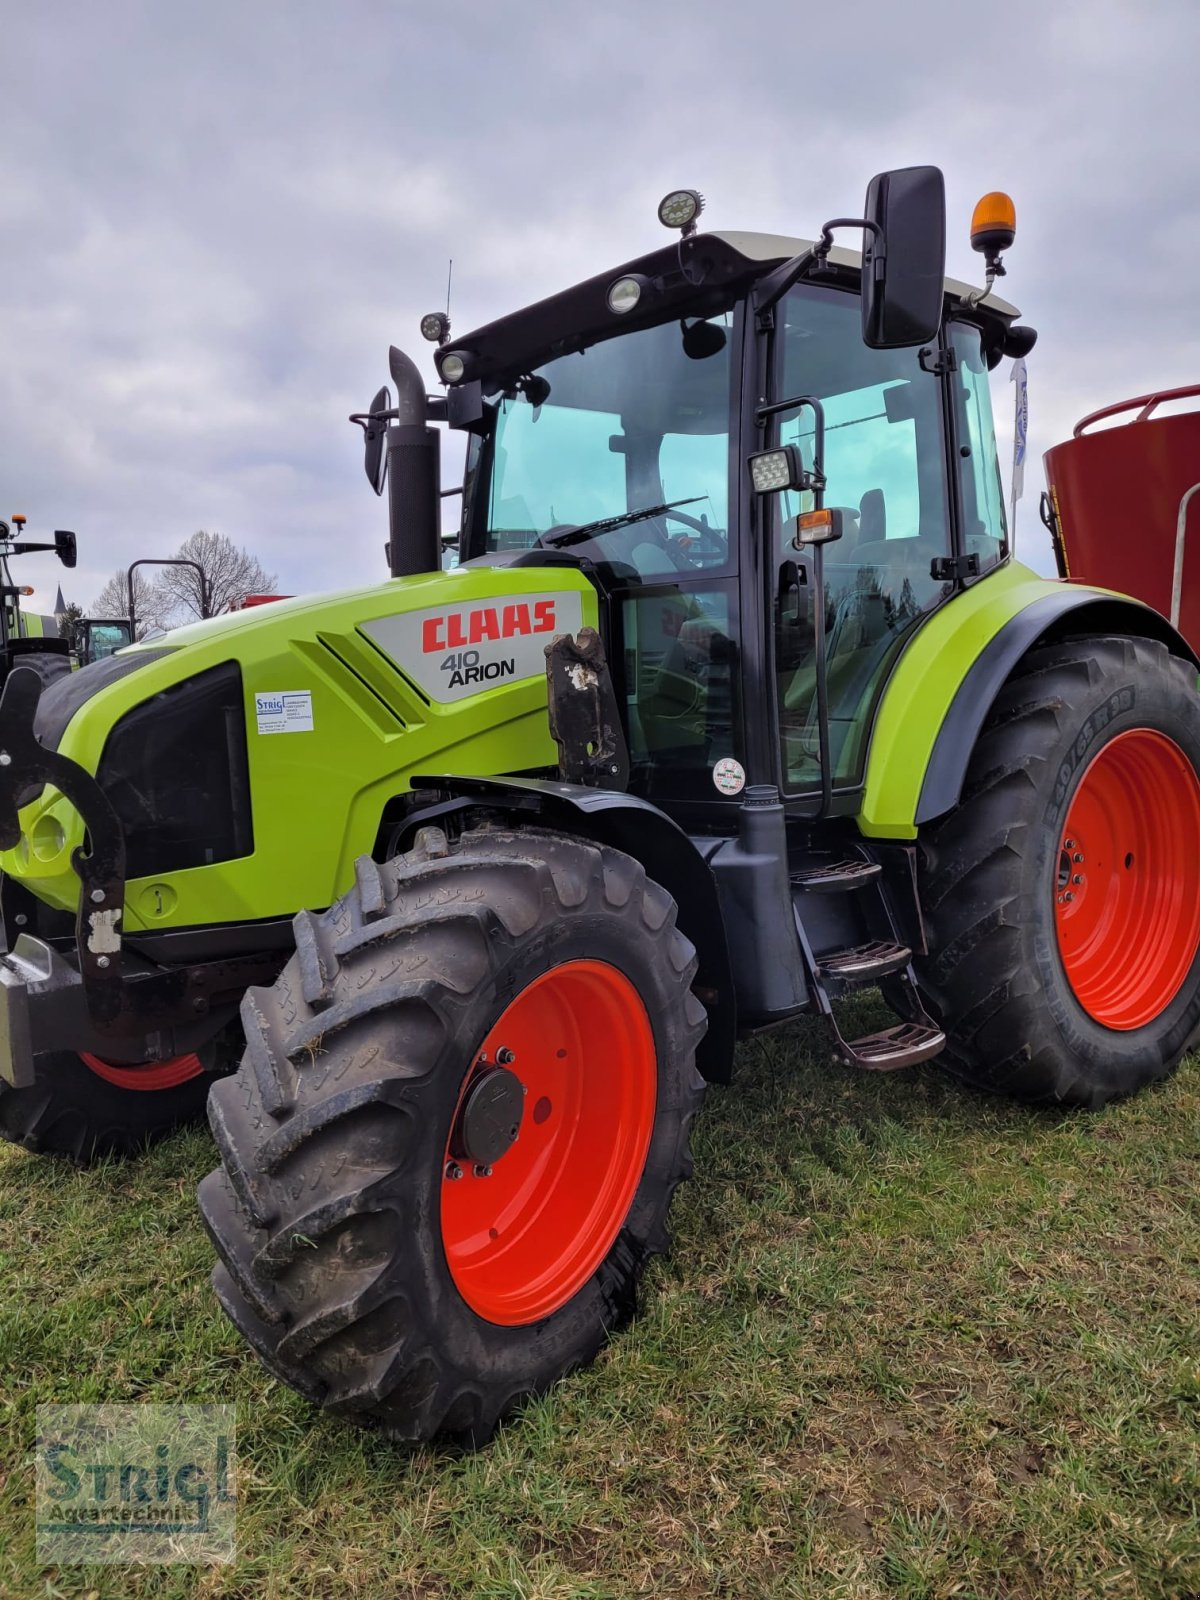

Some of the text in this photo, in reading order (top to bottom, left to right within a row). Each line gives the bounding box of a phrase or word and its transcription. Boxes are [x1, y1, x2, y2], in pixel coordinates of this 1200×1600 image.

[422, 600, 556, 653] CLAAS
[440, 650, 480, 671] 410
[448, 658, 515, 688] ARION
